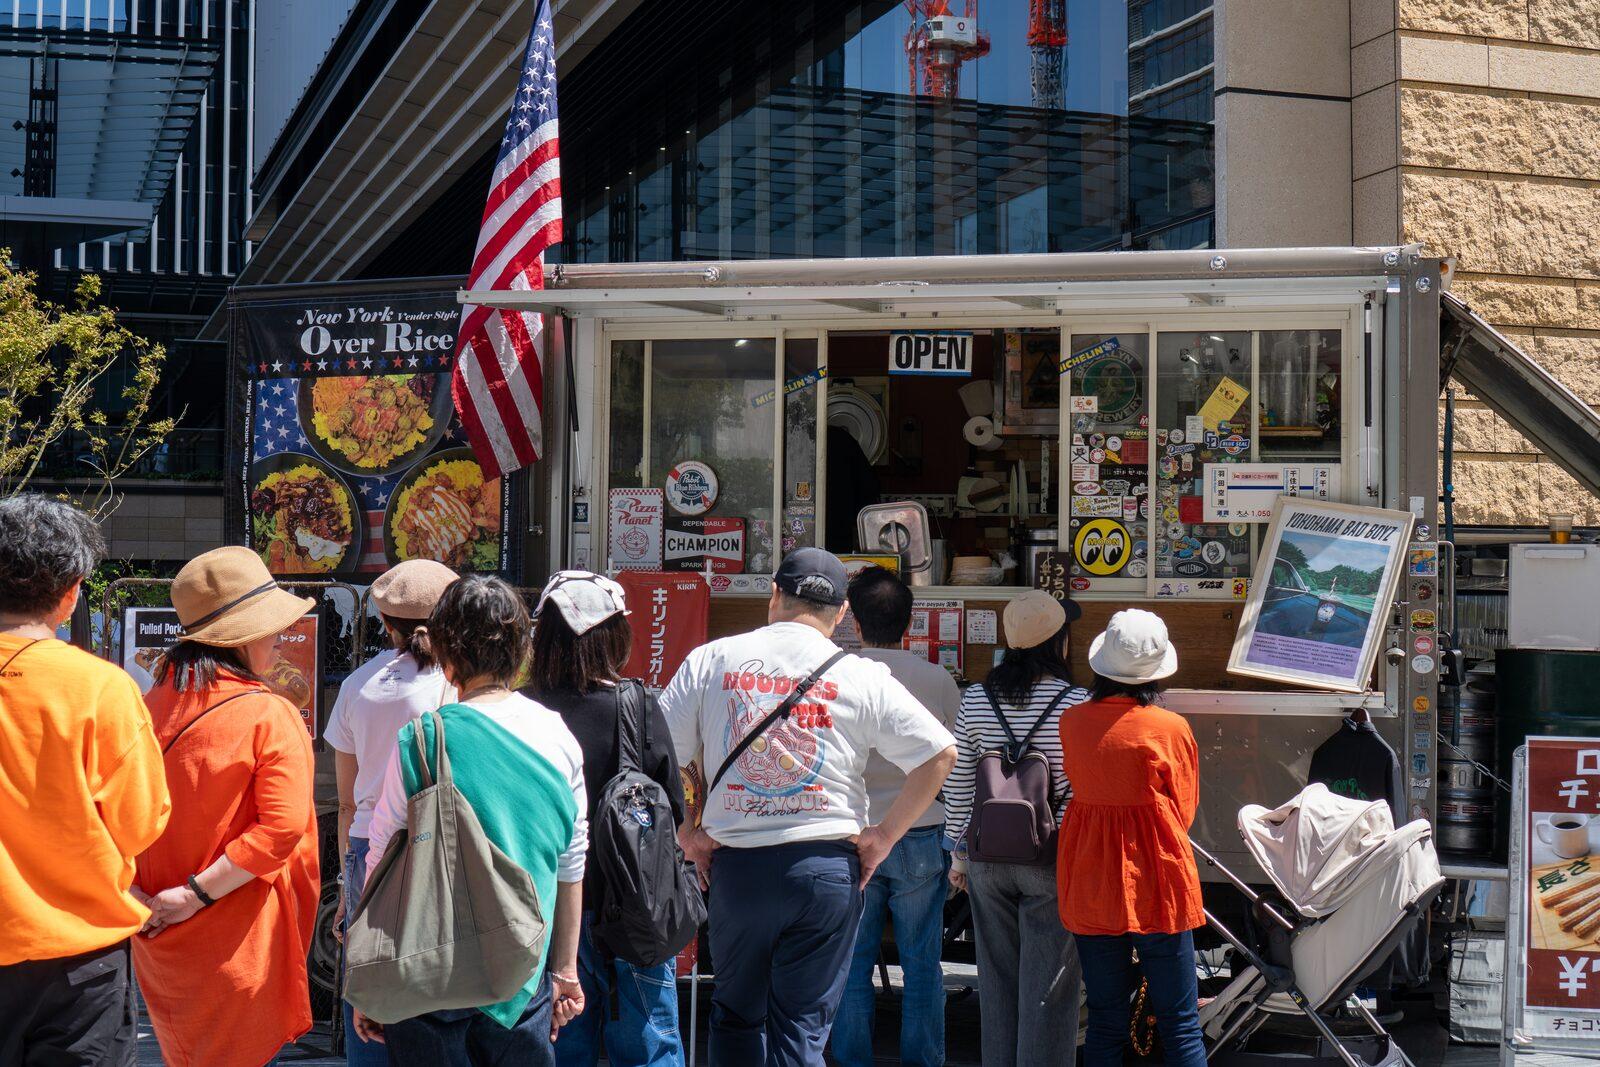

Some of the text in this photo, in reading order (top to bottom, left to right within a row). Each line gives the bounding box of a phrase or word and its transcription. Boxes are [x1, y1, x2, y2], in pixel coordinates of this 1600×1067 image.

[296, 309, 342, 325] New
[347, 306, 394, 323] York
[434, 310, 459, 321] Style
[300, 322, 454, 356] Over Rice
[895, 335, 967, 369] OPEN
[755, 378, 806, 406] MICELIN
[1319, 470, 1327, 501] 北千住
[616, 510, 654, 526] Planet
[626, 497, 658, 513] Pizza
[1285, 512, 1398, 541] YOKOHAMA BAD BOYZ
[667, 537, 740, 552] CHAMPION
[1087, 537, 1120, 546] MOON
[140, 623, 182, 635] Pulled Pork
[722, 671, 839, 701] NOODES
[1558, 779, 1600, 809] チ
